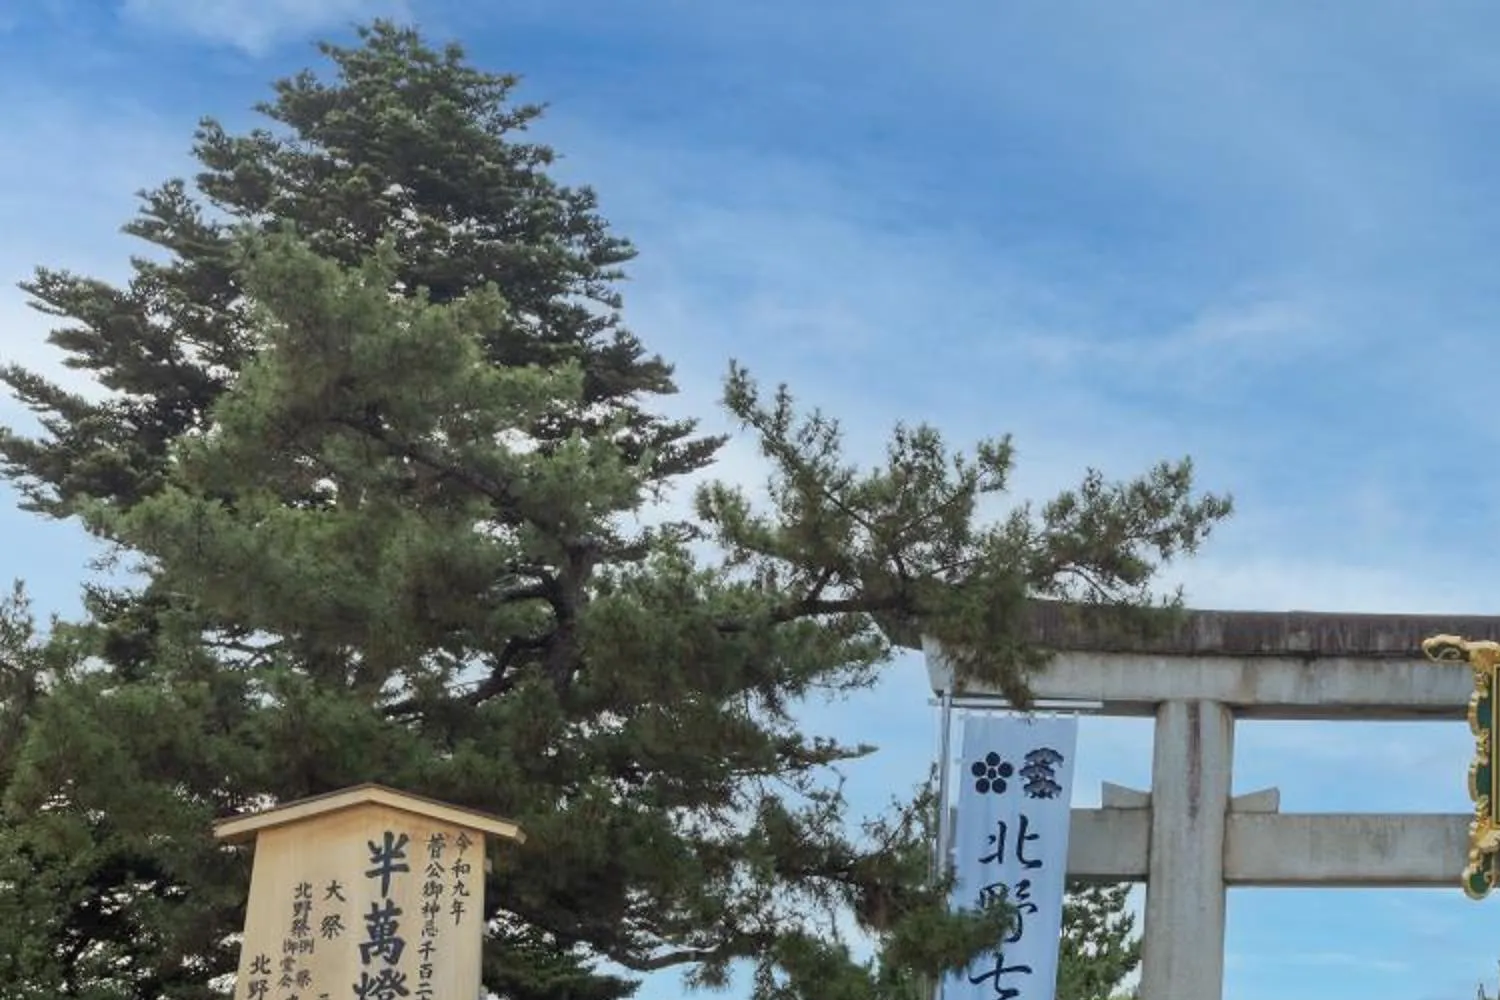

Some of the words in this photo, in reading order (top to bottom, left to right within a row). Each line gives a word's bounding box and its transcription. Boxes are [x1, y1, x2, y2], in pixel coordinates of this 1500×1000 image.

[321, 880, 346, 940] 大祭
[450, 832, 473, 925] 令和九年
